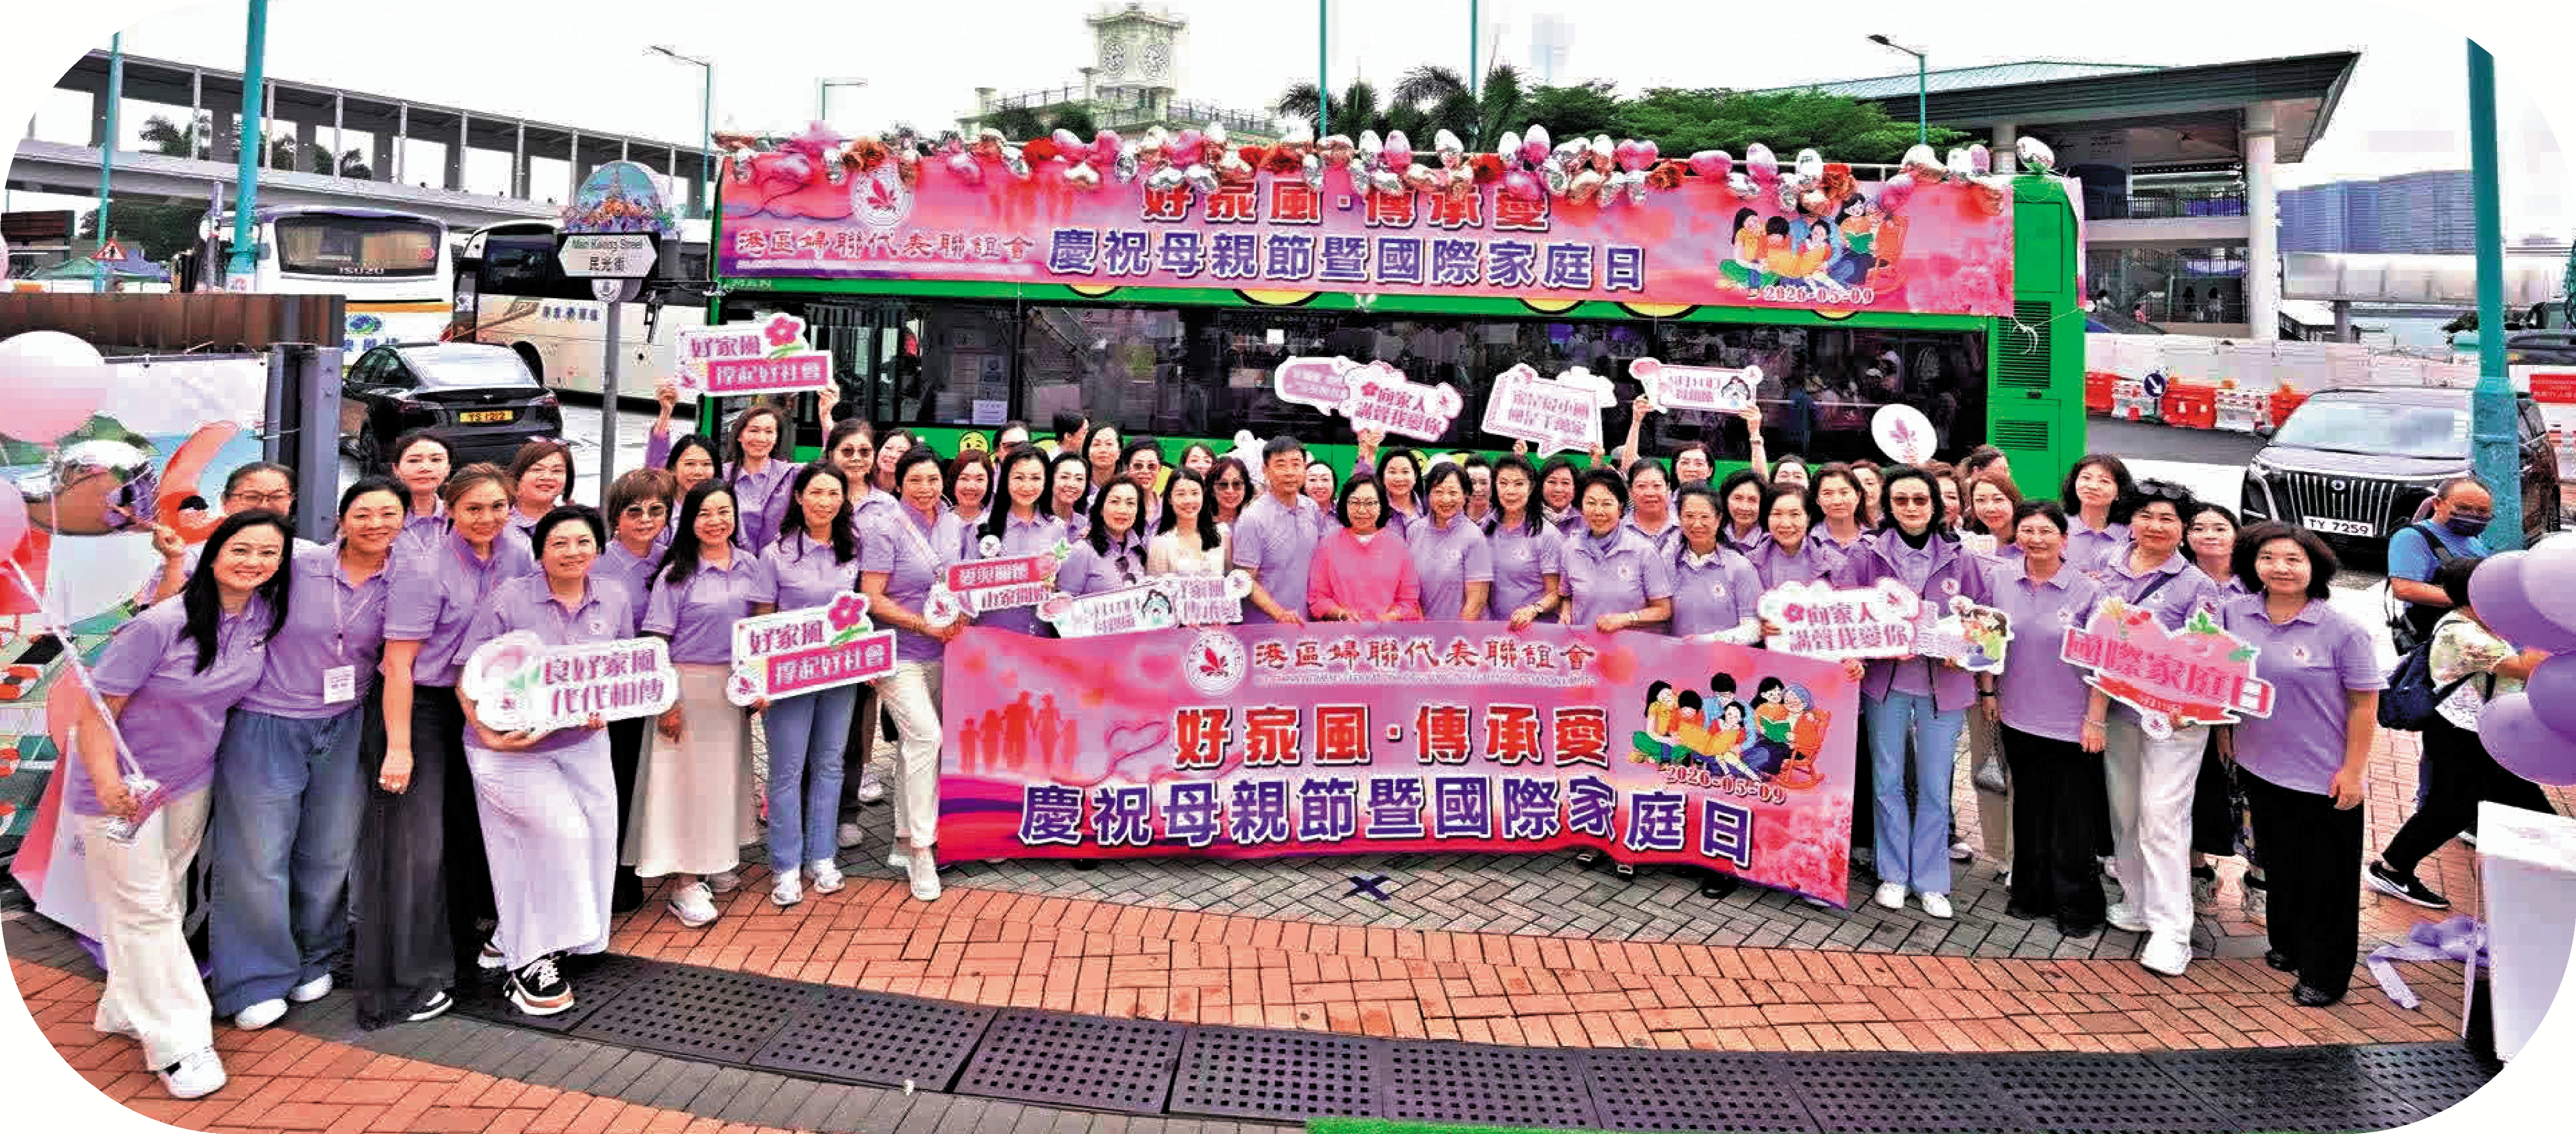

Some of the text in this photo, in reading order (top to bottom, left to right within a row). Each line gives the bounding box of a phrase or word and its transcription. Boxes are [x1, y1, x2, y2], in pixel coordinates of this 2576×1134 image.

[737, 230, 1033, 259] 港區婦聯代表聯誼會
[1049, 229, 1644, 290] 慶祝母親節暨國際家庭日
[589, 256, 625, 272] 民光街
[732, 279, 772, 290] MAN
[2309, 519, 2369, 535] TY 7259
[1806, 601, 1876, 625] 向家人
[749, 620, 825, 655] 好家風
[1255, 640, 1595, 670] 港區婦聯代表聯誼會
[543, 649, 657, 685] 良好家風
[552, 678, 664, 716] 代代相傳
[1175, 706, 1608, 766] 好家風·傳承愛
[1666, 766, 1788, 805] 2026-05-09
[1020, 776, 1751, 867] 慶祝母親節暨國際家庭日
